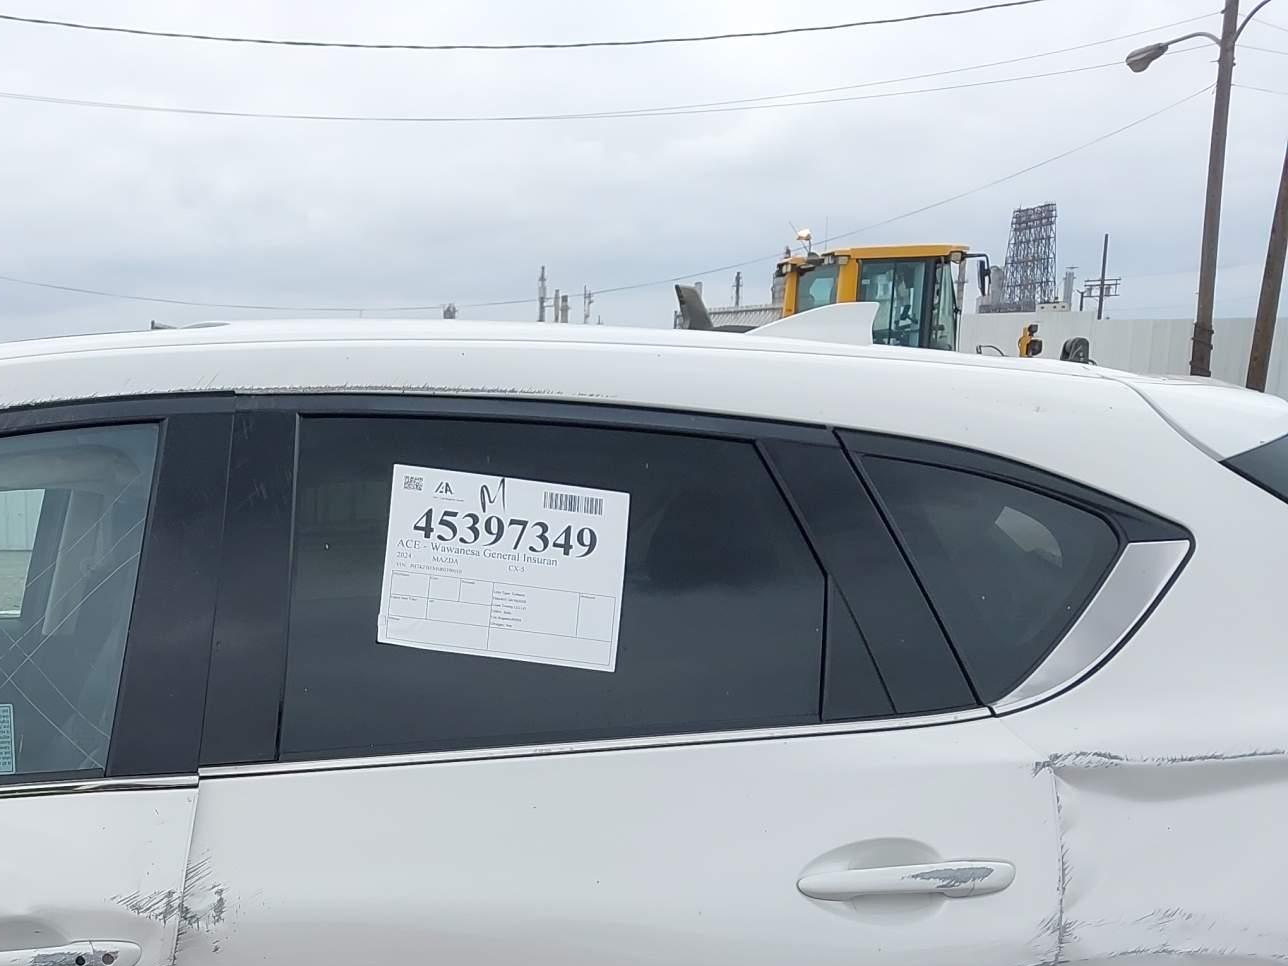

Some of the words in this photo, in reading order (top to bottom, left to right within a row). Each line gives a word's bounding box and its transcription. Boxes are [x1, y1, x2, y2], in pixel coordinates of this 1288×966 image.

[413, 508, 598, 558] 45397349
[396, 551, 412, 560] 2024
[432, 555, 459, 567] MAZDA
[397, 538, 421, 550] ACE
[430, 542, 481, 558] Wawanesa
[482, 548, 520, 563] General
[523, 552, 558, 567] Insuran
